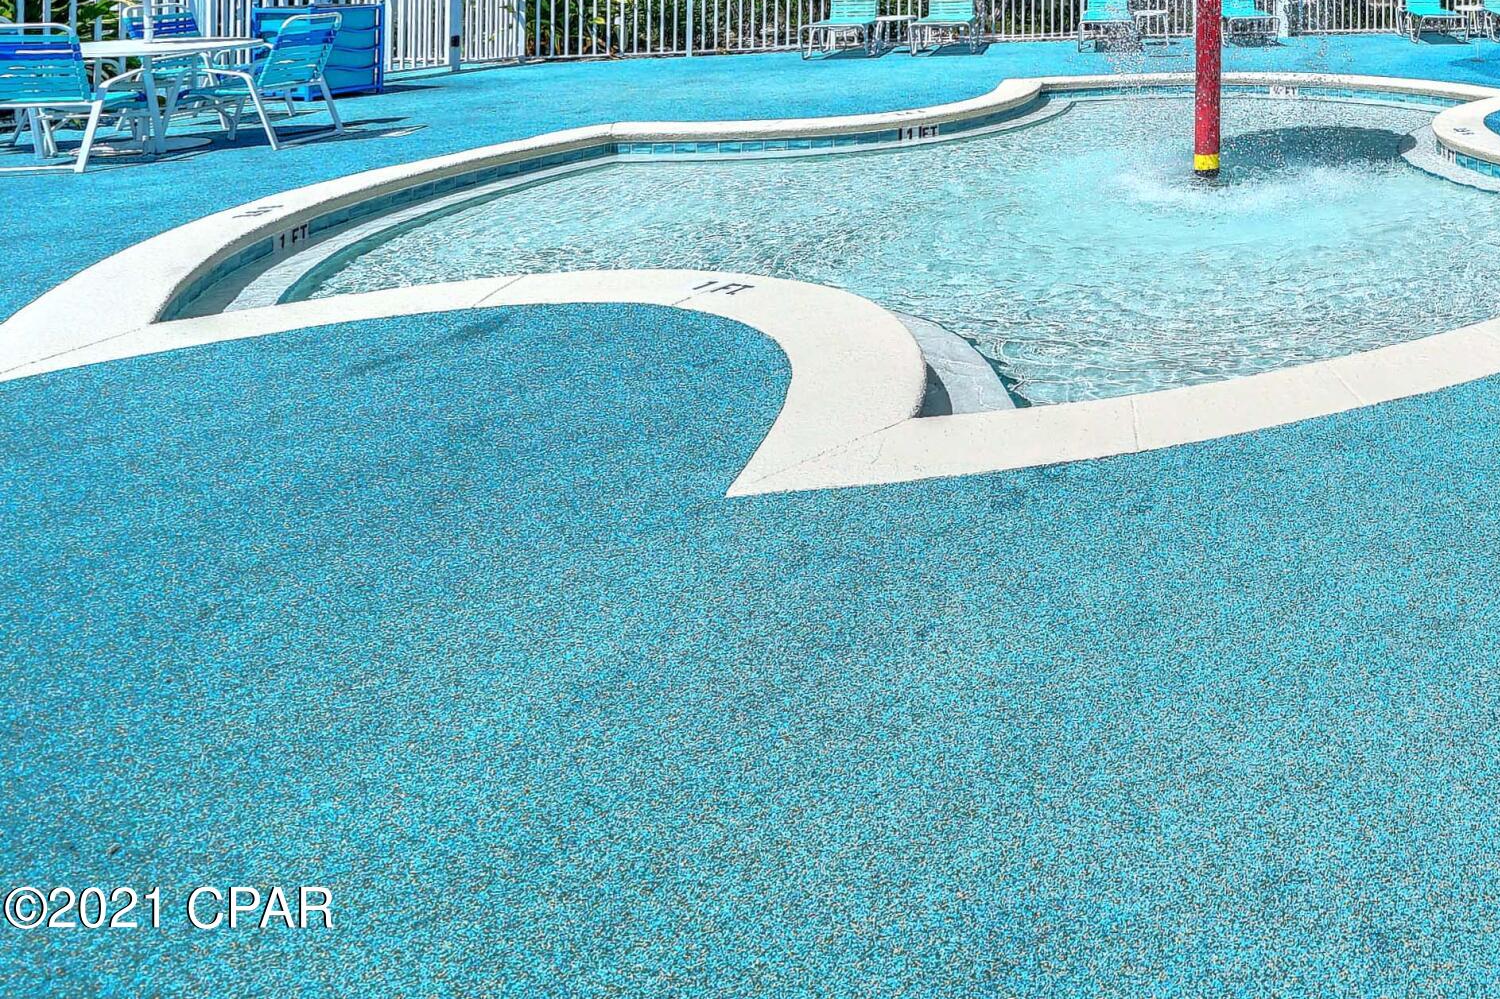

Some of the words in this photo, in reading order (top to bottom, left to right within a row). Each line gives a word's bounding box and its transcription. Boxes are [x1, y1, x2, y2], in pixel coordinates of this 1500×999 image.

[280, 233, 285, 248] 1
[291, 223, 308, 243] FT
[710, 283, 755, 295] FT
